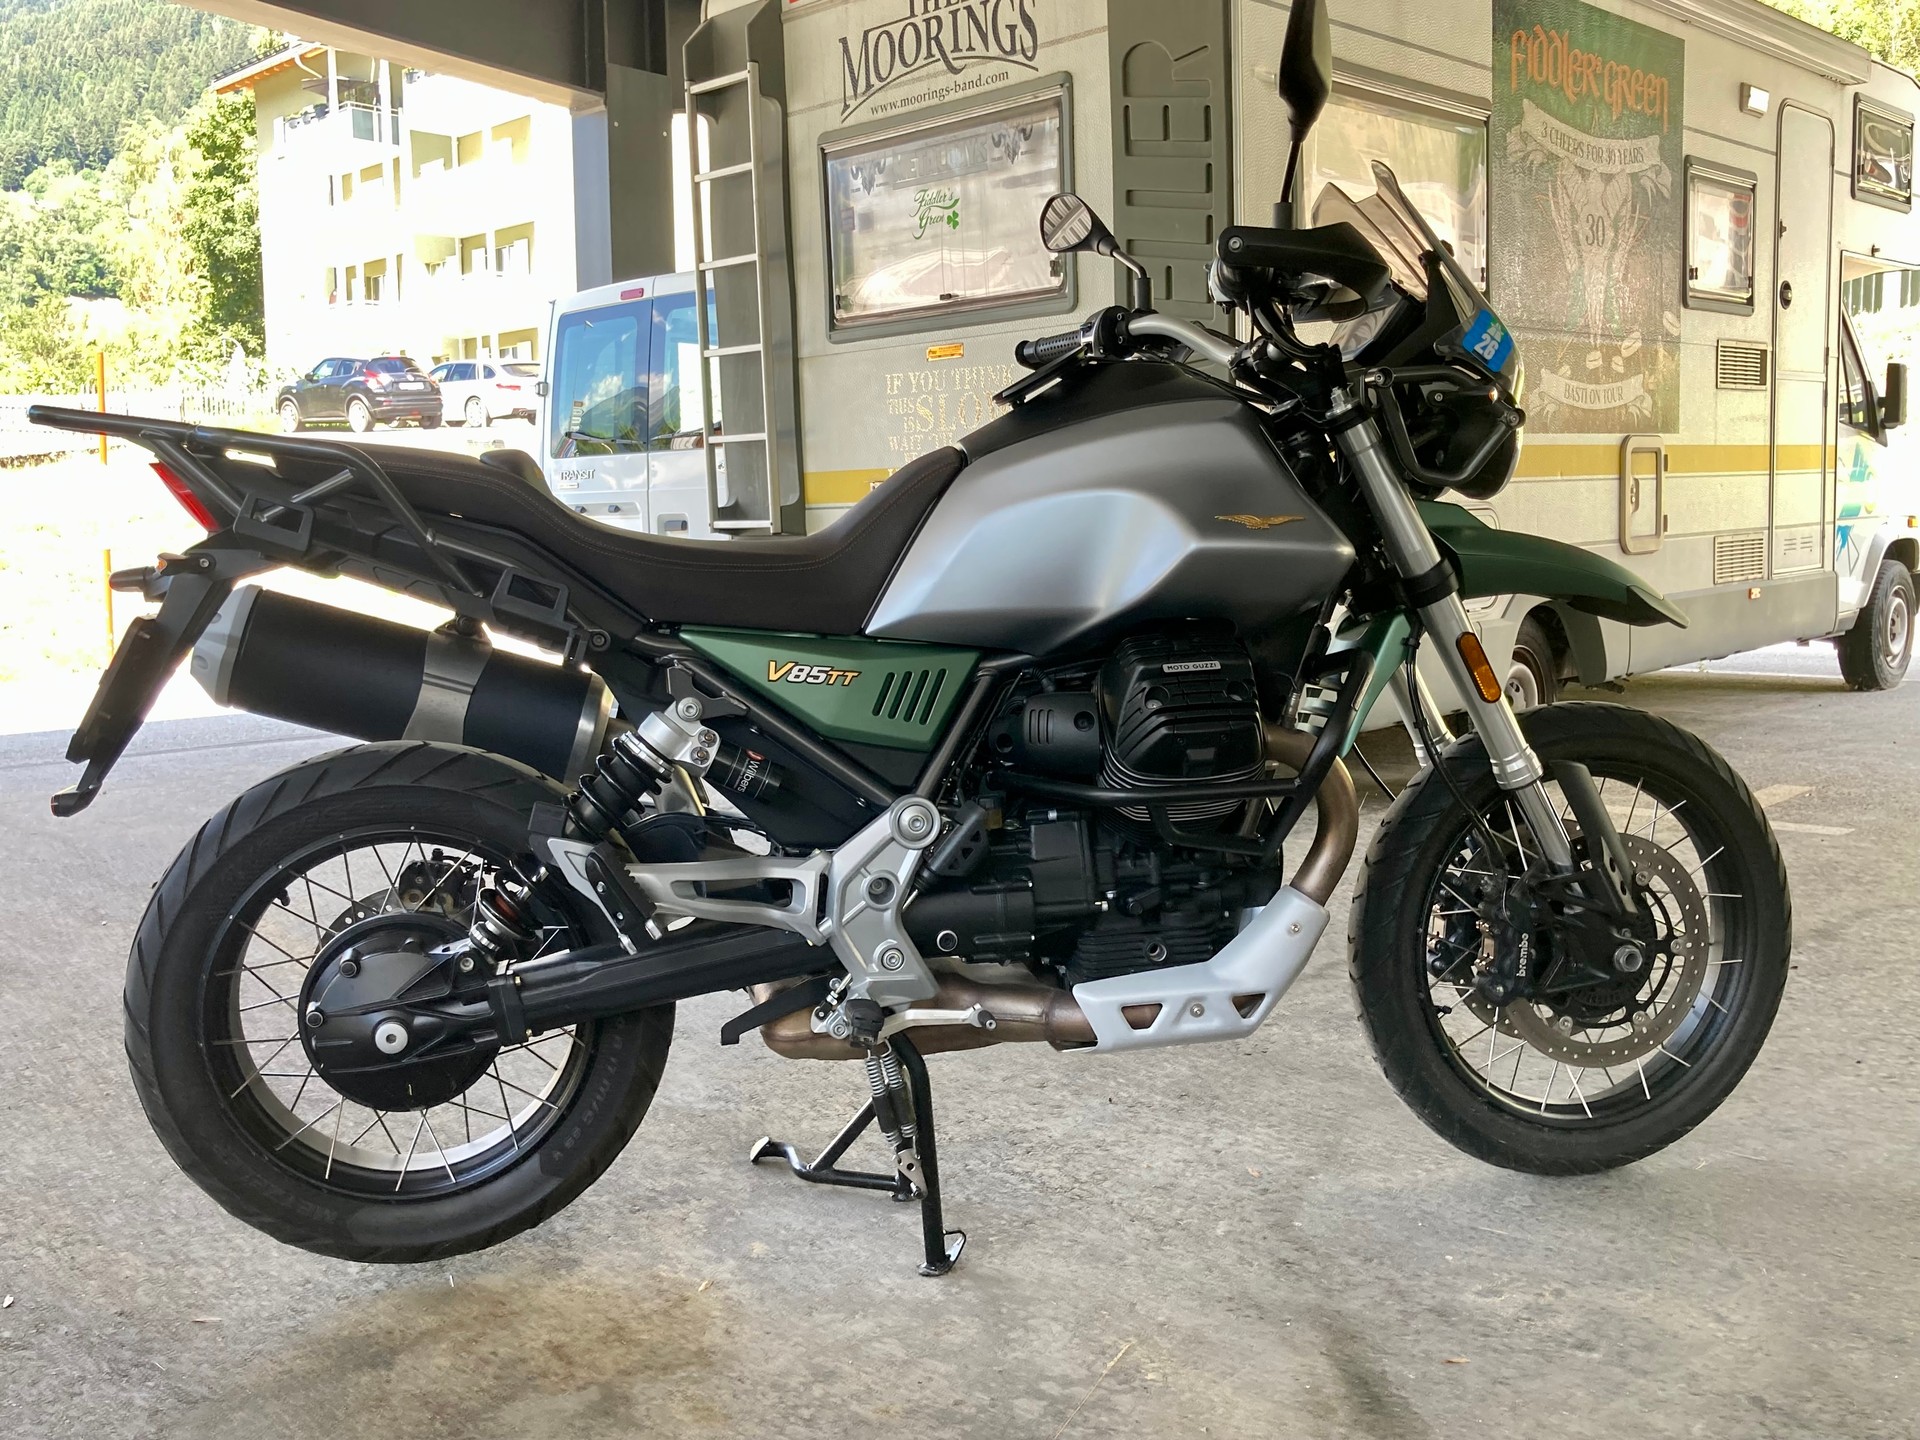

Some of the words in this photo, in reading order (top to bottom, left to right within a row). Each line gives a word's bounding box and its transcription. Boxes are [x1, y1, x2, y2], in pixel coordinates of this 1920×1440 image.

[838, 0, 1038, 116] MOORINGS
[870, 71, 1009, 116] www.moorings-band.com
[1540, 121, 1548, 138] 3
[1550, 127, 1585, 159] CHEERS
[1586, 144, 1603, 163] FOR
[1617, 146, 1645, 165] YEARS
[911, 207, 945, 240] Green
[1584, 213, 1606, 248] 30
[1474, 332, 1499, 360] 26
[885, 373, 903, 395] IF
[908, 368, 946, 394] YOU
[951, 363, 1016, 391] THINK
[1588, 388, 1600, 404] ON
[1601, 385, 1624, 402] TOUR
[560, 469, 596, 481] TRANSIT
[1192, 662, 1217, 670] GUZZI
[737, 760, 760, 793] Wilbers
[1516, 932, 1528, 977] brembo
